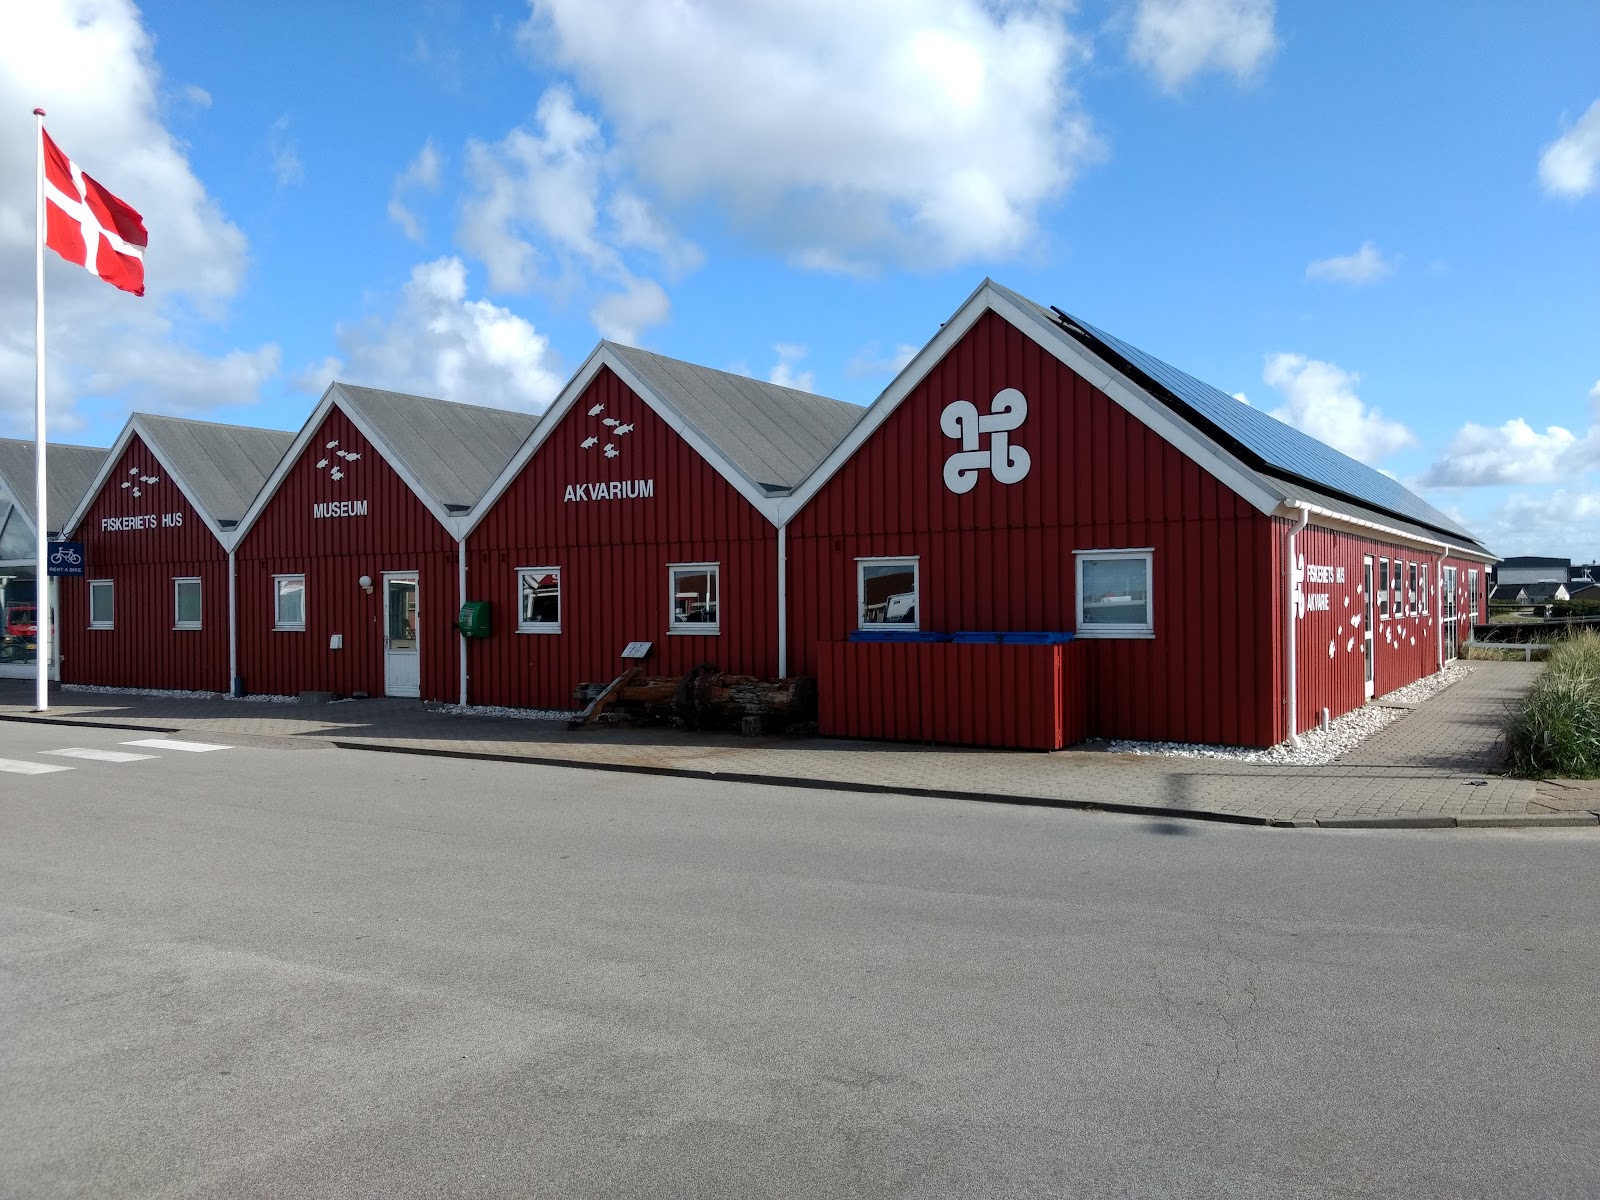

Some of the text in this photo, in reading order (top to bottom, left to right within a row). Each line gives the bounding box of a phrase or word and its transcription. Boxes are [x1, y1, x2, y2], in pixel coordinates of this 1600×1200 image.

[563, 479, 654, 503] AKVARIUM
[313, 500, 368, 519] MUSEUM
[101, 512, 183, 532] FISKERIETS HUS
